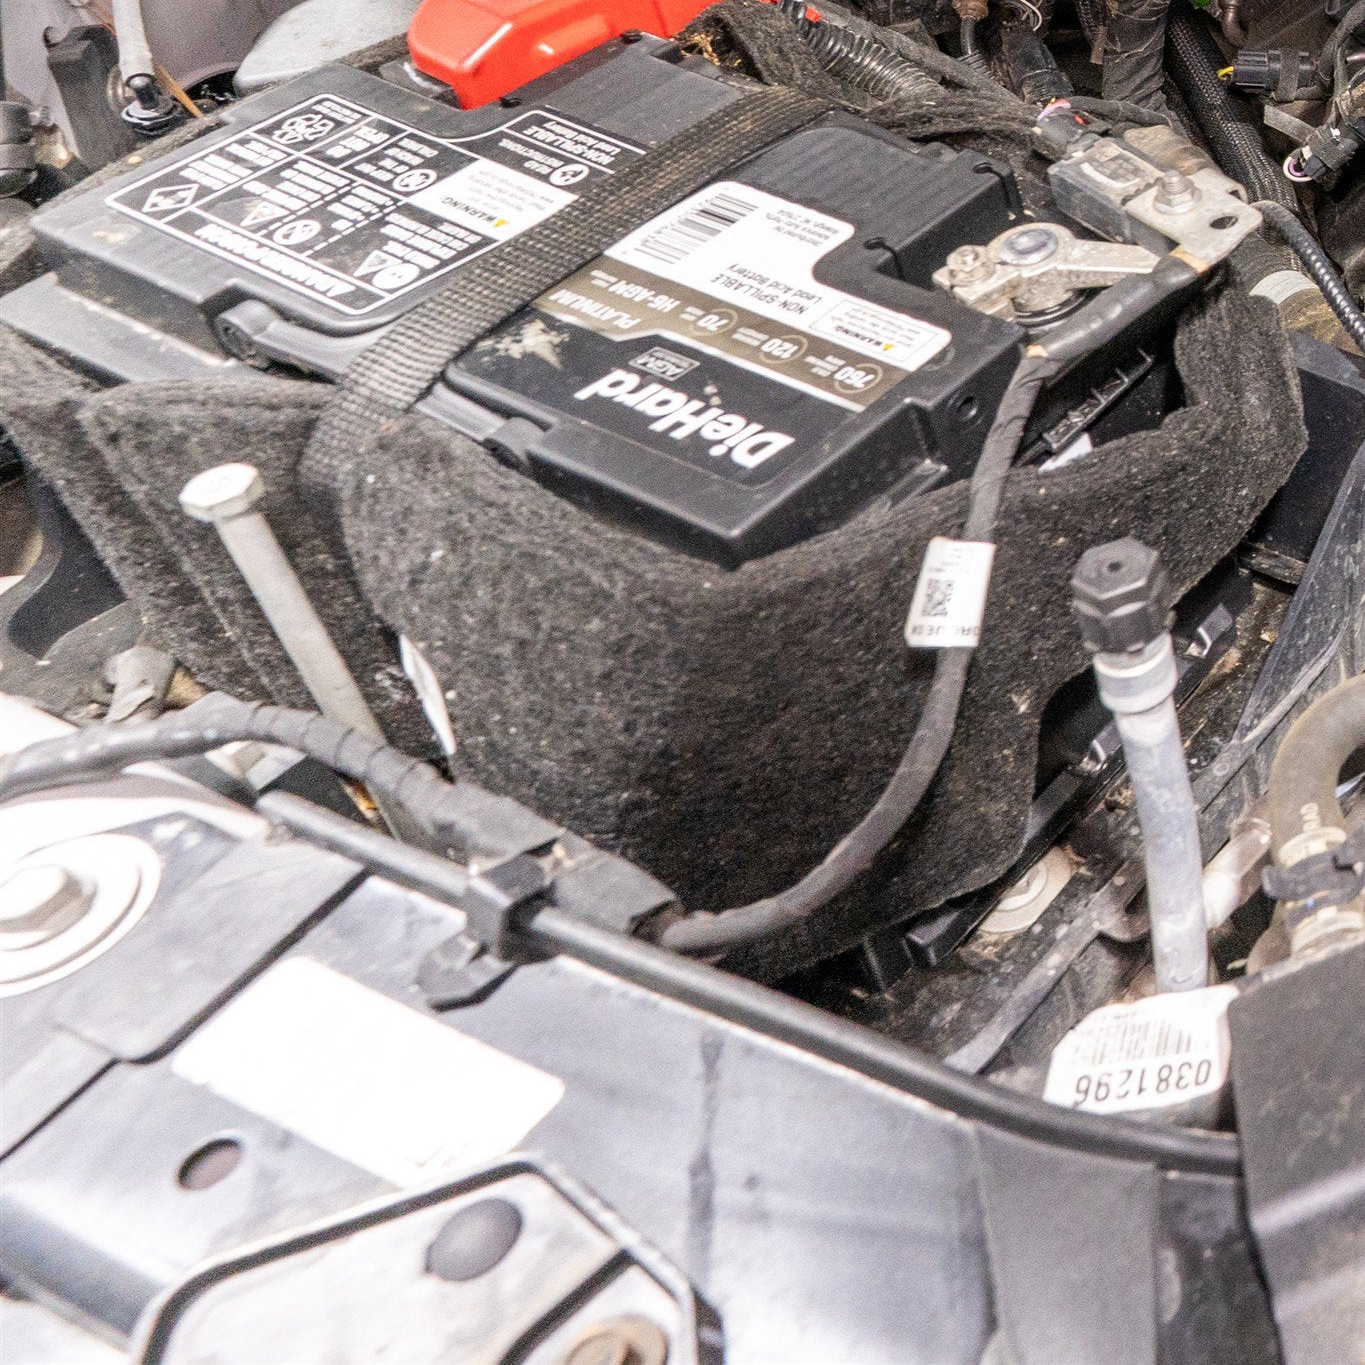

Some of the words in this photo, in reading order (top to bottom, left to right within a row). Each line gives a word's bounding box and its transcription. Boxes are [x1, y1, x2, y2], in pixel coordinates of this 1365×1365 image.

[723, 263, 771, 285] Battery
[709, 272, 809, 314] NON-SPILLABLE
[766, 280, 795, 294] Acid
[789, 288, 823, 305] Lead
[548, 288, 642, 330] PLATINUM
[694, 313, 730, 332] 70
[759, 337, 798, 359] 120
[573, 365, 796, 470] DieHard
[1073, 1058, 1213, 1108] 0381296
